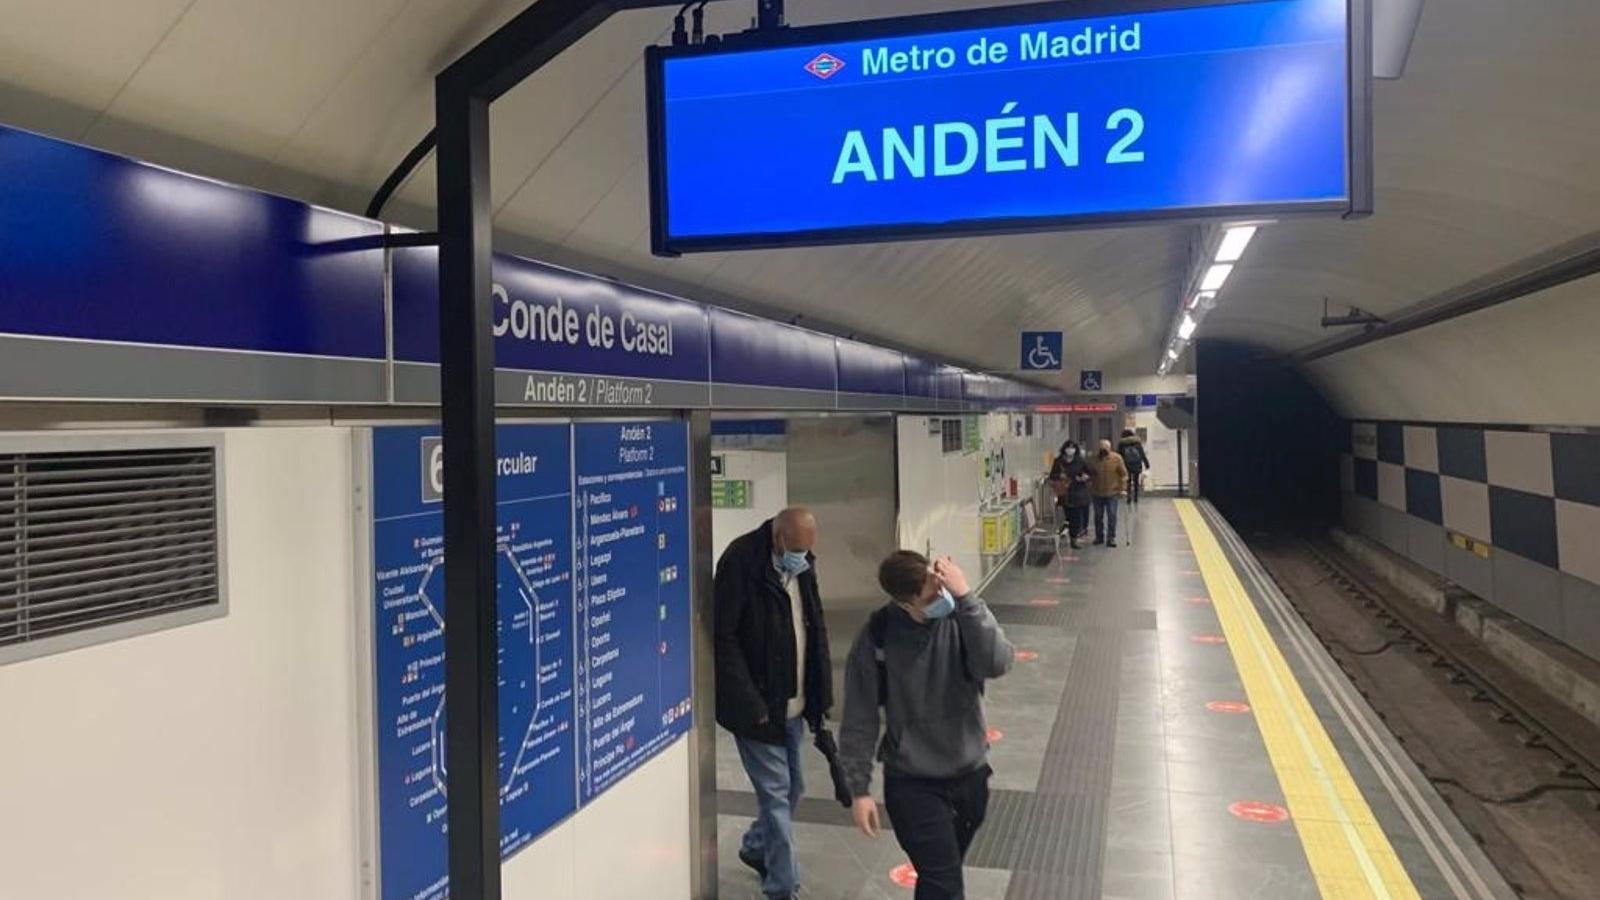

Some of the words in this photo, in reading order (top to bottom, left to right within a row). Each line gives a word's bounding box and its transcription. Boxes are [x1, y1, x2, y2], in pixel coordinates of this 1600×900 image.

[862, 47, 955, 76] Metro
[966, 38, 1007, 66] de
[1019, 22, 1141, 61] Madrid
[831, 102, 1079, 184] ANDÉN
[1105, 108, 1145, 164] 2
[492, 283, 579, 345] Conde
[586, 305, 614, 349] de
[620, 311, 673, 356] Casal
[524, 375, 575, 401] Andén
[578, 380, 587, 401] 2
[596, 380, 644, 404] Platform
[645, 384, 652, 404] 2
[621, 423, 645, 440] Andén
[646, 425, 652, 440] 2
[430, 445, 444, 493] 6
[497, 452, 538, 476] rcular
[649, 446, 654, 461] 2
